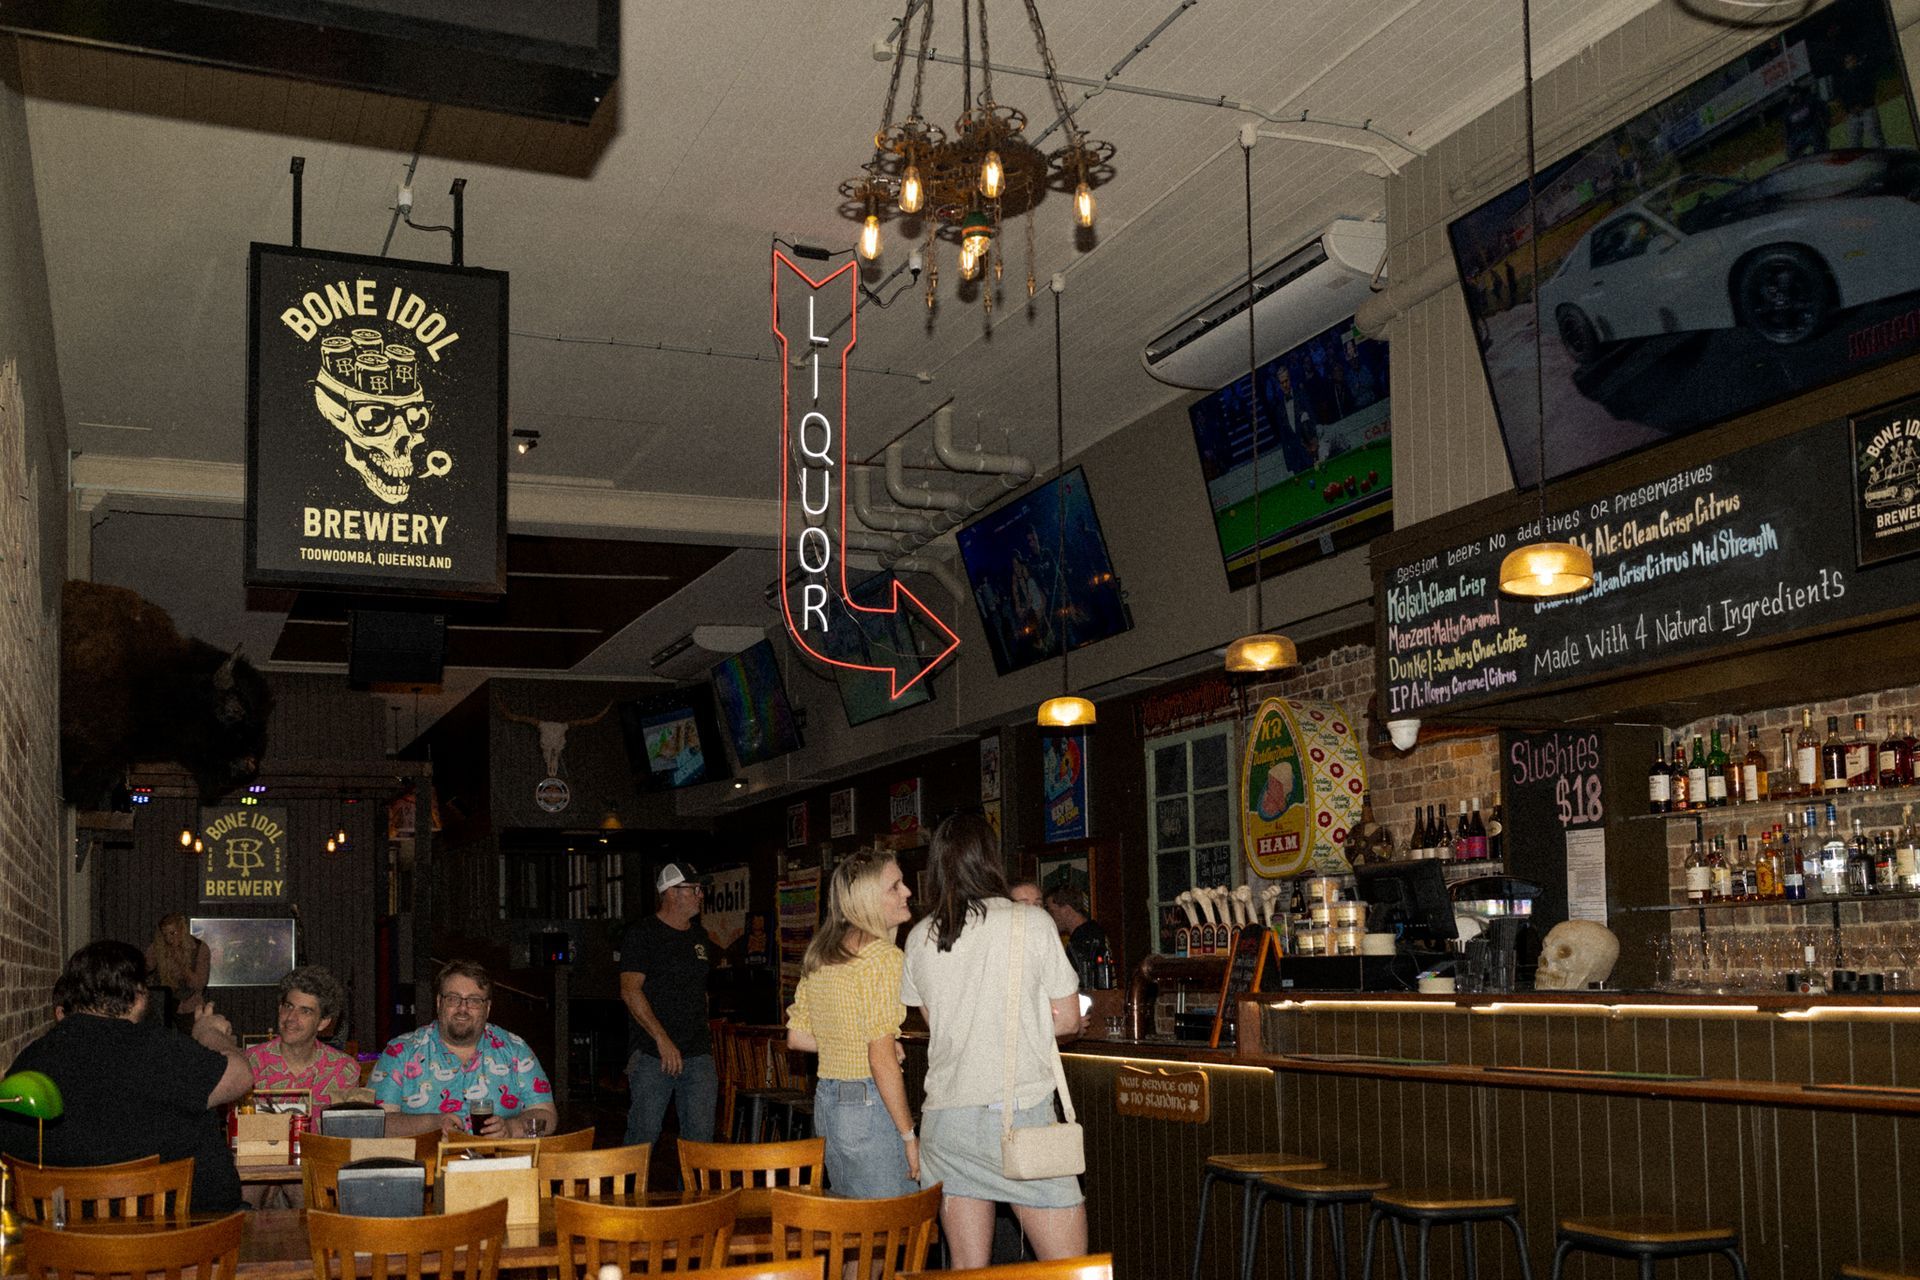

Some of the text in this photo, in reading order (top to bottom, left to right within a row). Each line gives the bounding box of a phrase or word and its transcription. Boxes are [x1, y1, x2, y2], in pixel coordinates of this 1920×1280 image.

[281, 280, 460, 362] BONE IDOL
[1867, 421, 1903, 458] BONE
[800, 295, 834, 632] LIQUOR
[303, 507, 449, 545] BREWERY
[1447, 541, 1481, 566] beers
[1489, 533, 1506, 553] NO
[1591, 500, 1609, 520] OR
[1615, 464, 1713, 514] Preservatives
[1695, 492, 1740, 526] Citrus
[300, 547, 452, 569] TOOWOOMBA, QUEENSLAND
[1646, 551, 1689, 580] Citrus
[1692, 534, 1719, 566] Mid
[1719, 522, 1779, 560] Strength
[1460, 575, 1486, 597] Crisp
[1460, 599, 1500, 636] Caramel
[1534, 568, 1845, 676] Made With 4 Natural Ingredients
[1452, 667, 1490, 695] Caramel
[1489, 667, 1517, 687] Citrus
[1511, 733, 1600, 785] Slushies
[1556, 773, 1603, 828] $18
[205, 811, 284, 845] BONE IDOL
[1259, 834, 1299, 855] HAM
[205, 879, 284, 897] BREWERY
[704, 880, 745, 914] Mobil
[1178, 1081, 1200, 1097] only
